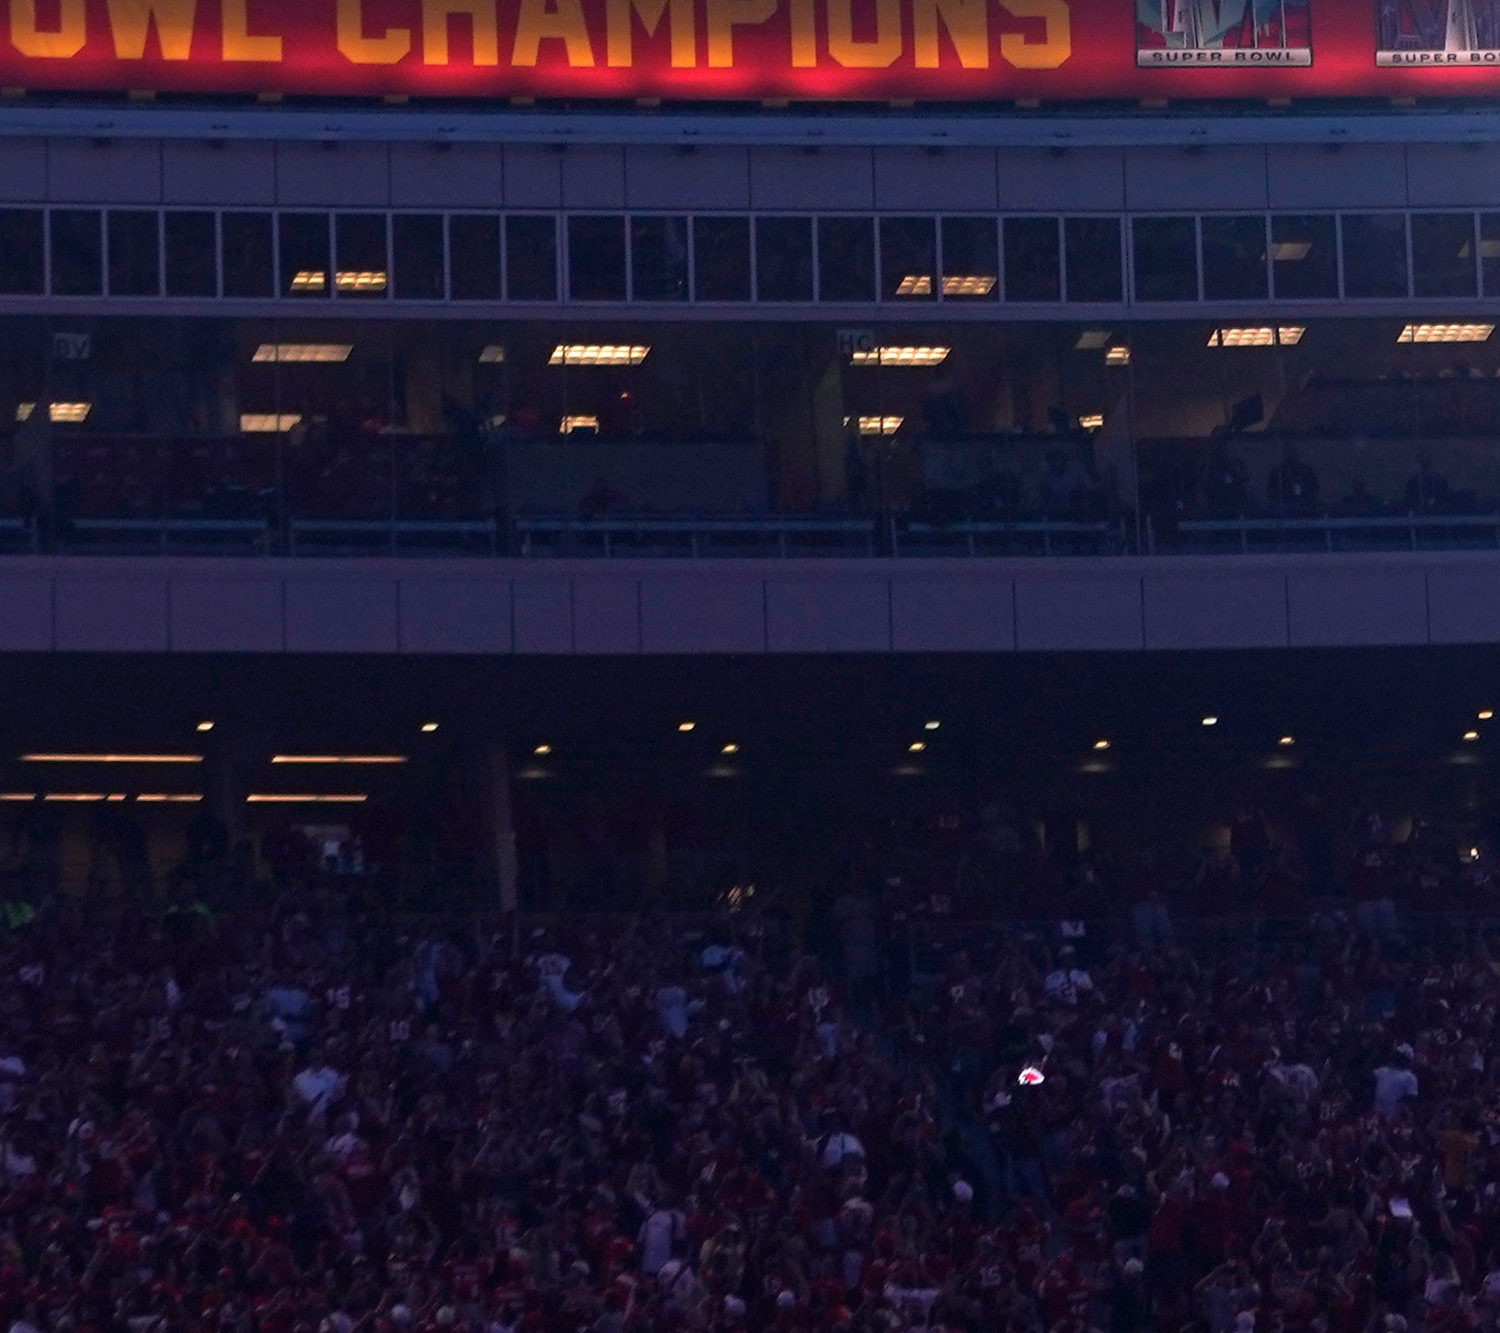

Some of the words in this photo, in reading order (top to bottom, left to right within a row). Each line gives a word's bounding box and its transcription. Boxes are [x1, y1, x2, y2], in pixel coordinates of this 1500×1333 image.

[1152, 52, 1222, 62] SUPER
[1234, 52, 1295, 61] BOWL
[1391, 53, 1458, 63] SUPER
